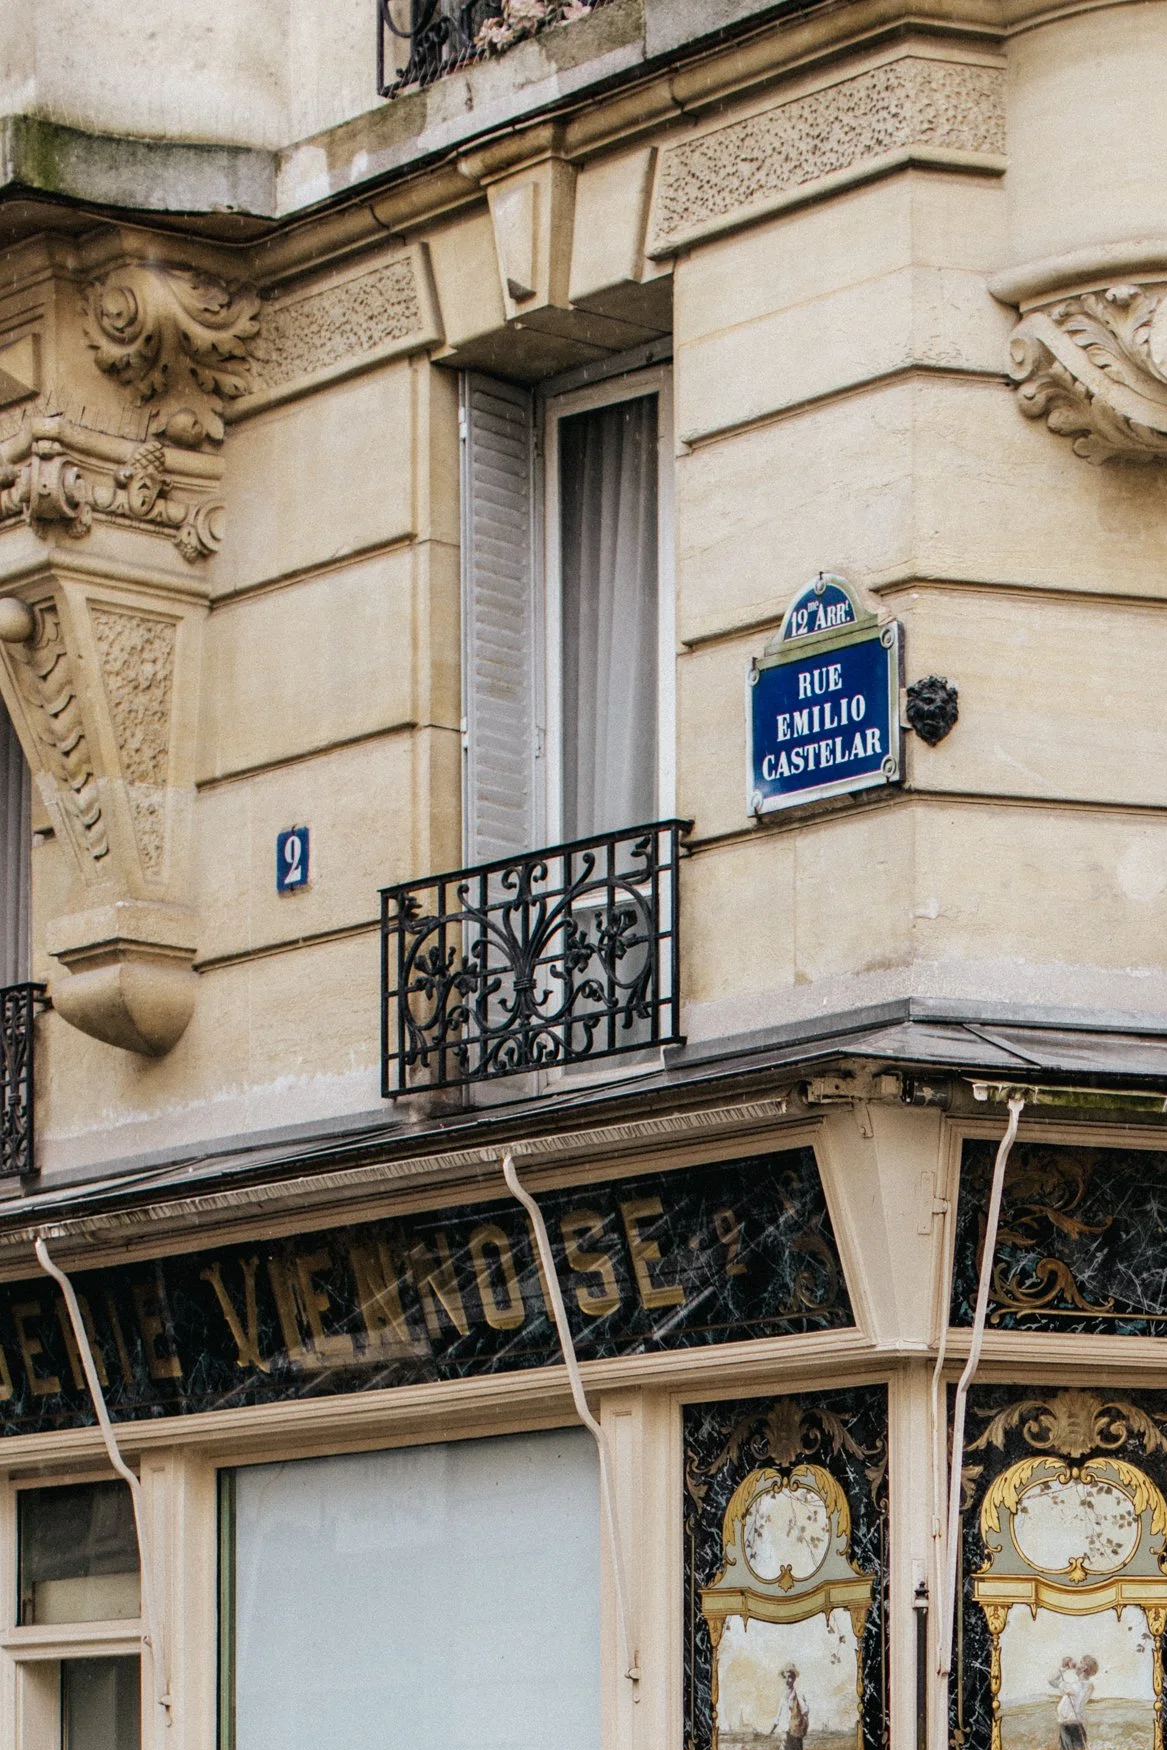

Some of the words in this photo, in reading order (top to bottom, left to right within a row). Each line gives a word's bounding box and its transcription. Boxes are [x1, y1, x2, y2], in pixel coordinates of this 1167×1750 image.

[798, 663, 842, 700] RUE
[776, 694, 866, 742] EMILIO
[762, 727, 882, 781] CASTELAR
[283, 835, 302, 885] 2
